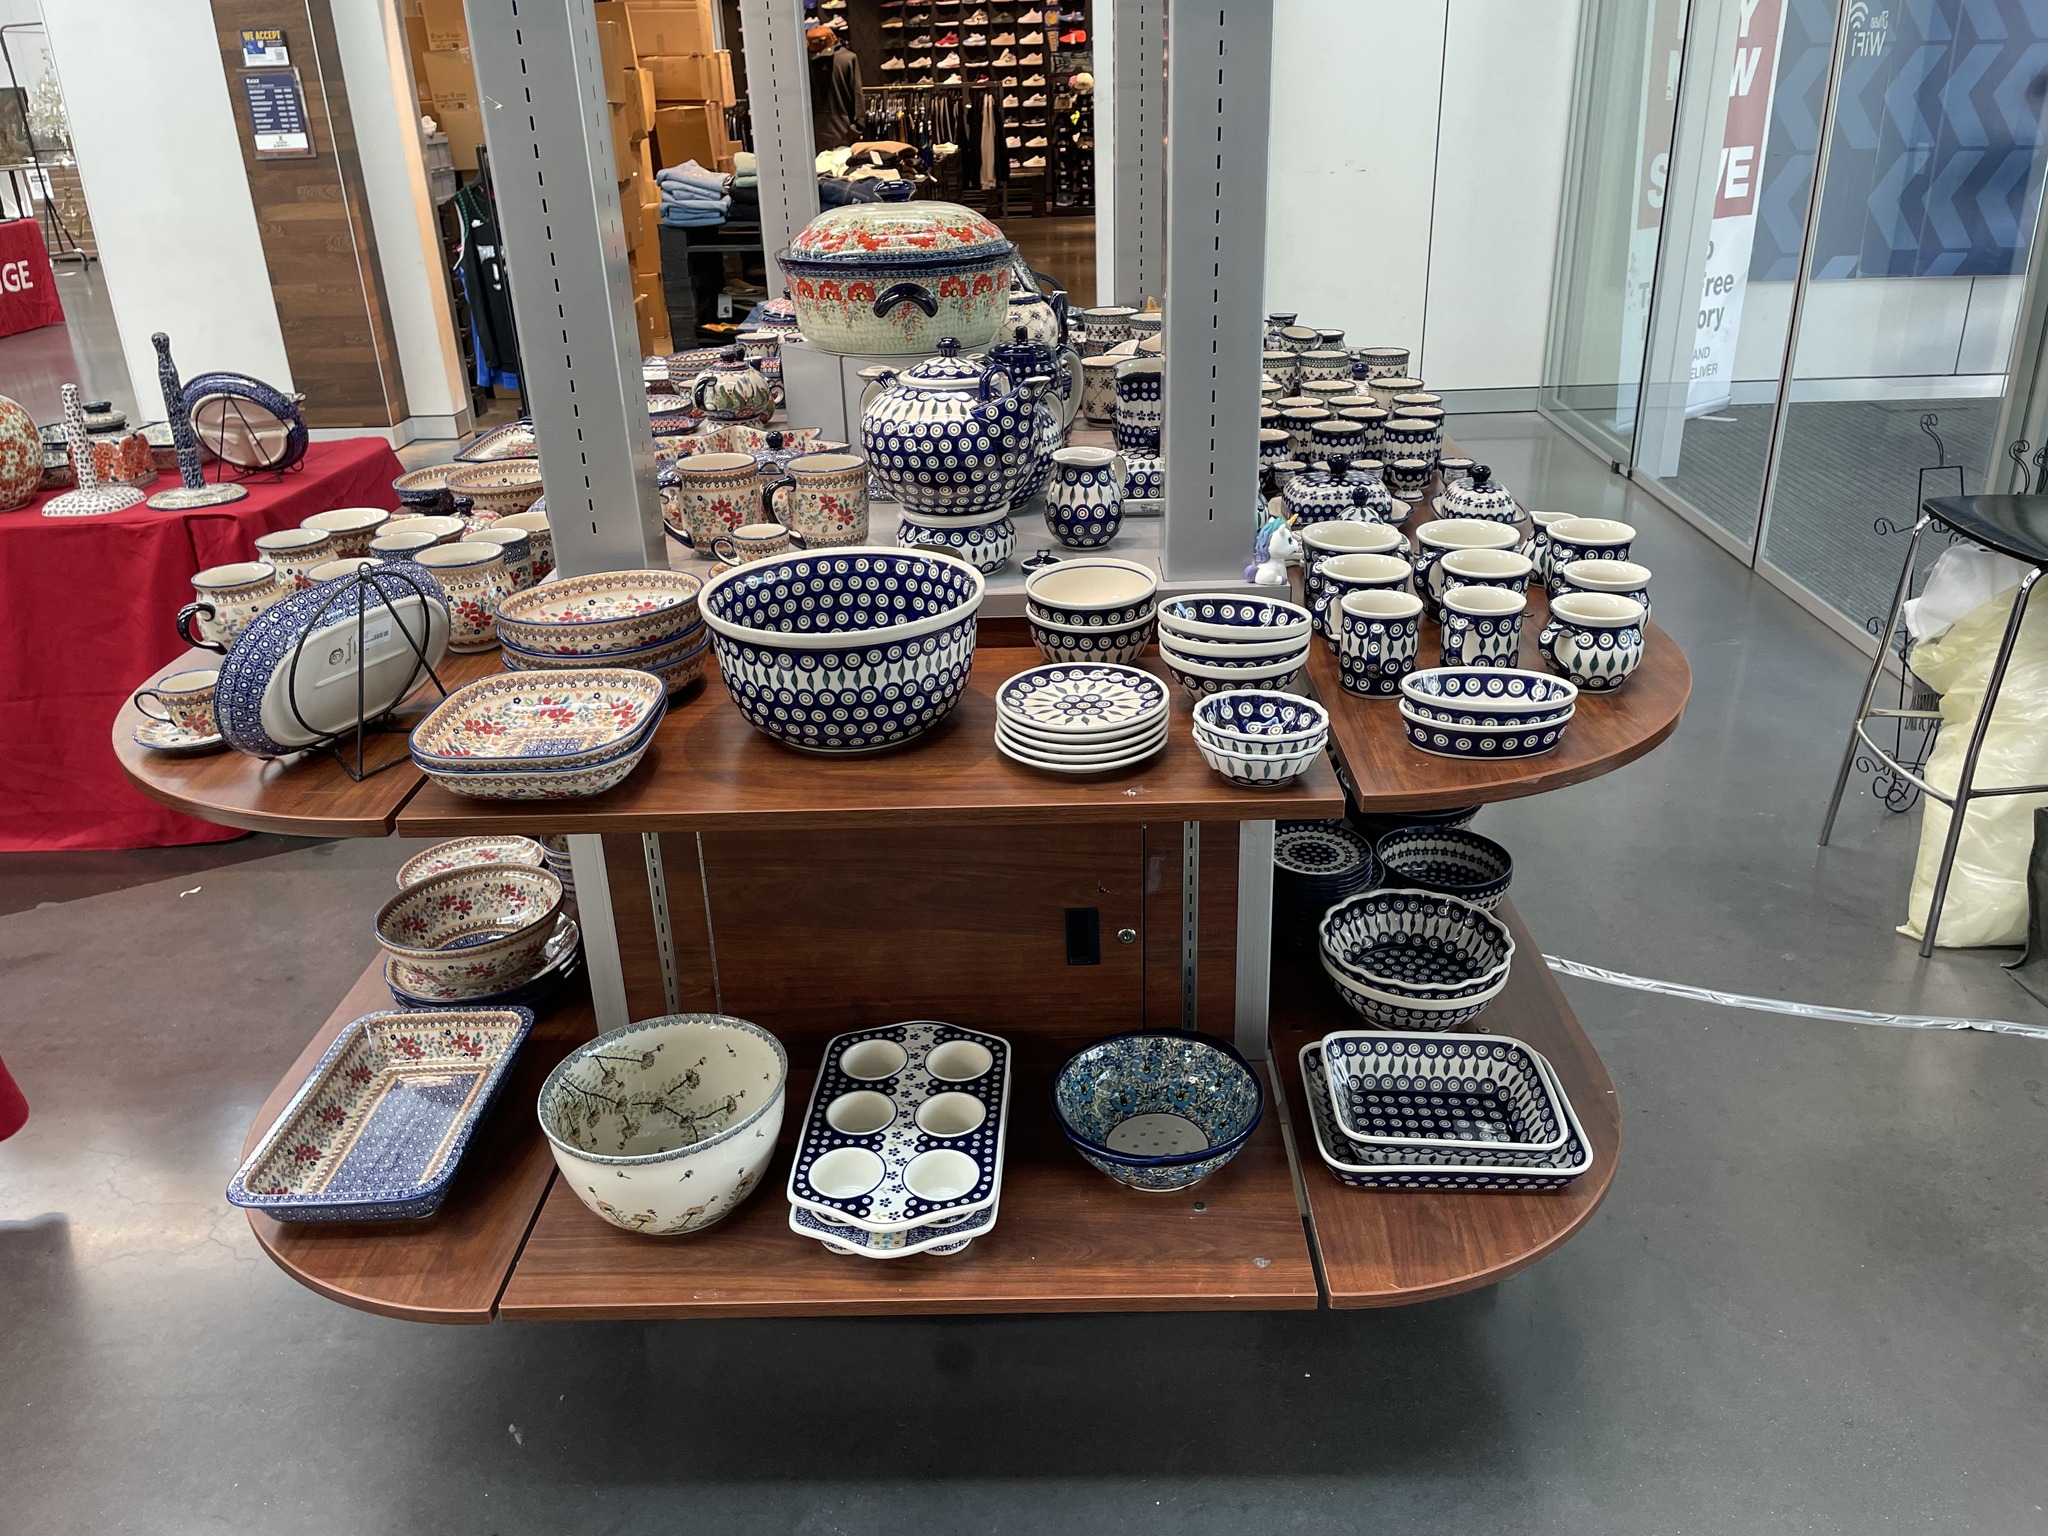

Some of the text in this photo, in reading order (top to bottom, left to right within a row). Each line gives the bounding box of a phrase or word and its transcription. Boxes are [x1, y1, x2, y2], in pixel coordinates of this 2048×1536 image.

[242, 30, 280, 41] WE ACCEPT
[0, 260, 34, 294] GE
[1697, 306, 1725, 332] ory
[1690, 363, 1718, 380] ELIVER
